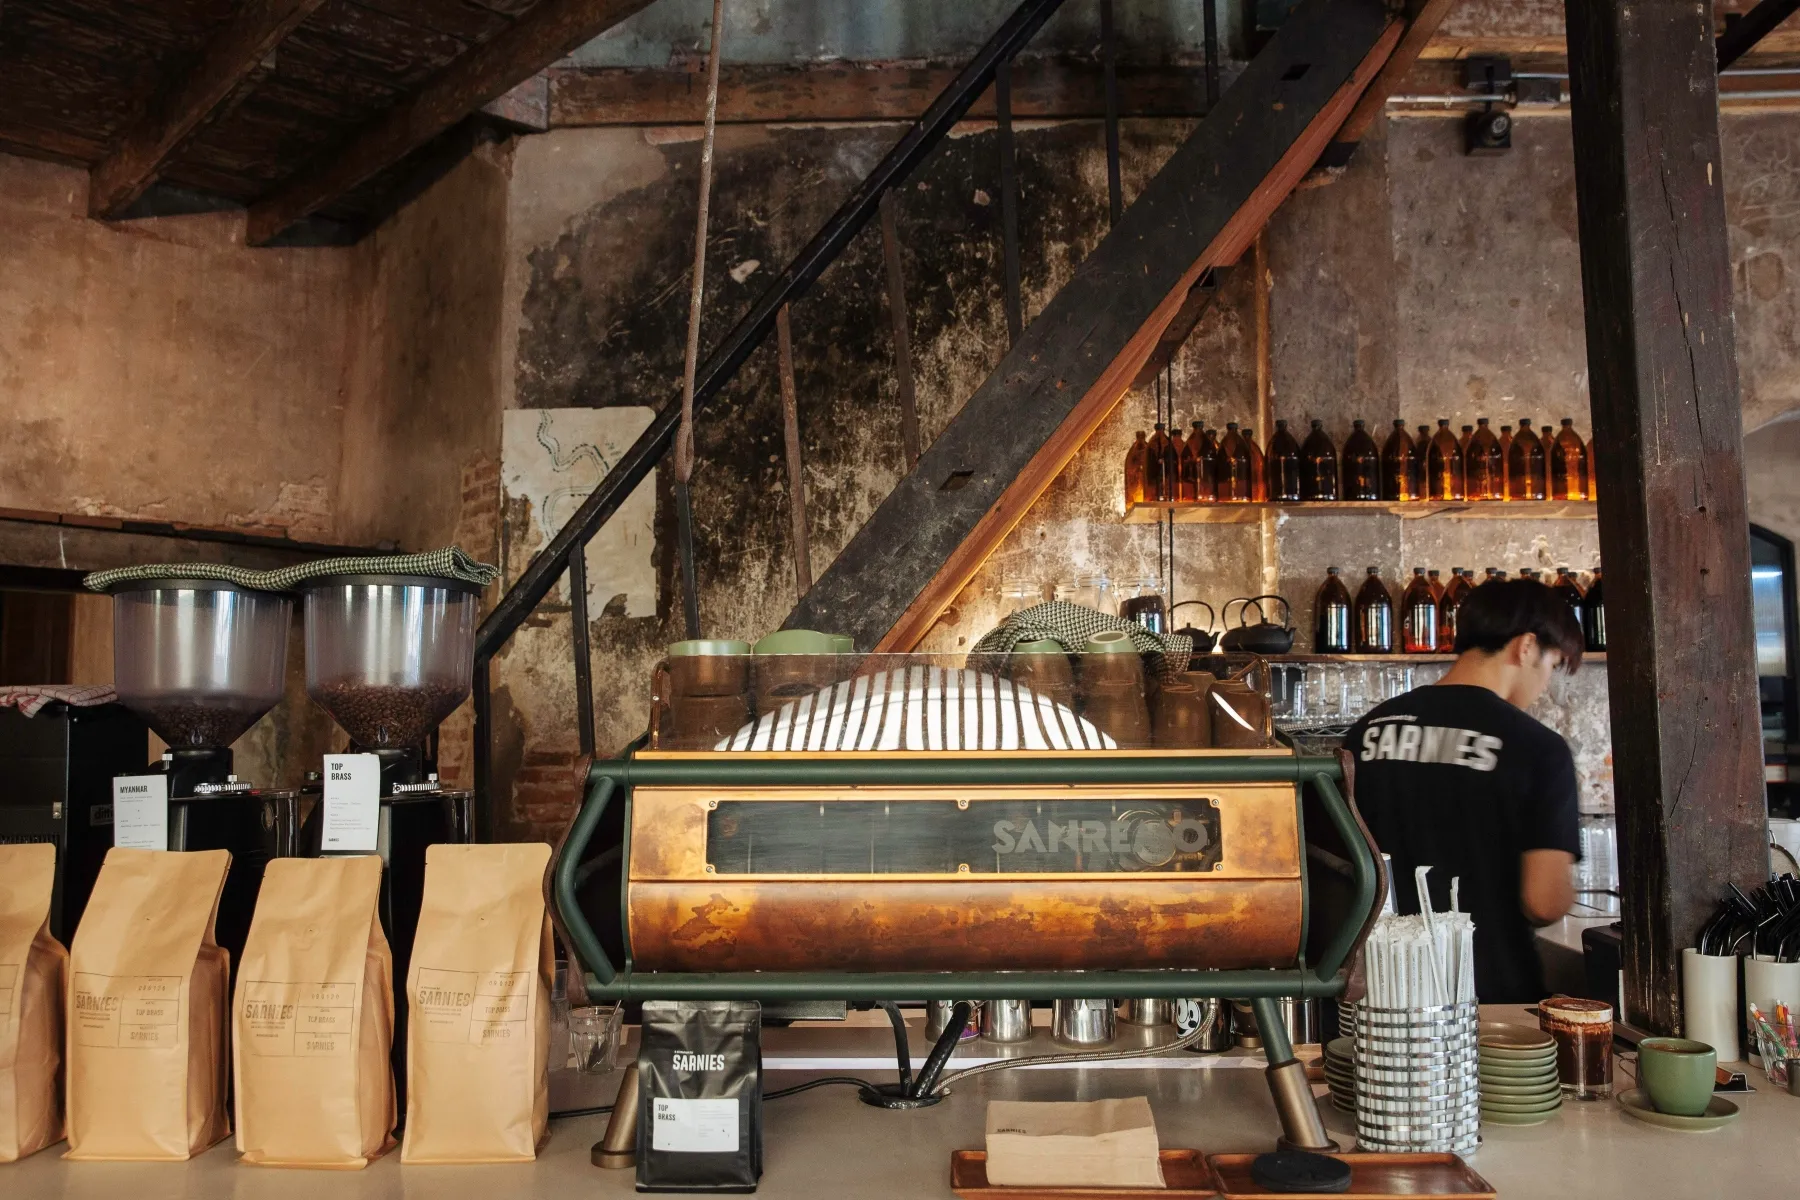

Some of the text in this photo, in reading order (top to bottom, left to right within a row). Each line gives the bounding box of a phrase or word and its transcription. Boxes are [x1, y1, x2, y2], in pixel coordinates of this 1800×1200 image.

[1360, 723, 1503, 772] SARNIES
[330, 763, 343, 771] TOP
[330, 772, 352, 781] BRASS
[119, 785, 148, 794] MYANMAR
[75, 994, 119, 1011] SARNIES
[419, 990, 471, 1007] SARNIES
[245, 1004, 294, 1020] SARNIES
[308, 1015, 336, 1024] TOP BRASS
[130, 1031, 159, 1041] SARNIES
[482, 1029, 511, 1039] SARNIES
[306, 1041, 335, 1051] SARNIES
[672, 1054, 725, 1072] SARNIES
[658, 1104, 669, 1112] TOP
[657, 1112, 676, 1121] BRASS
